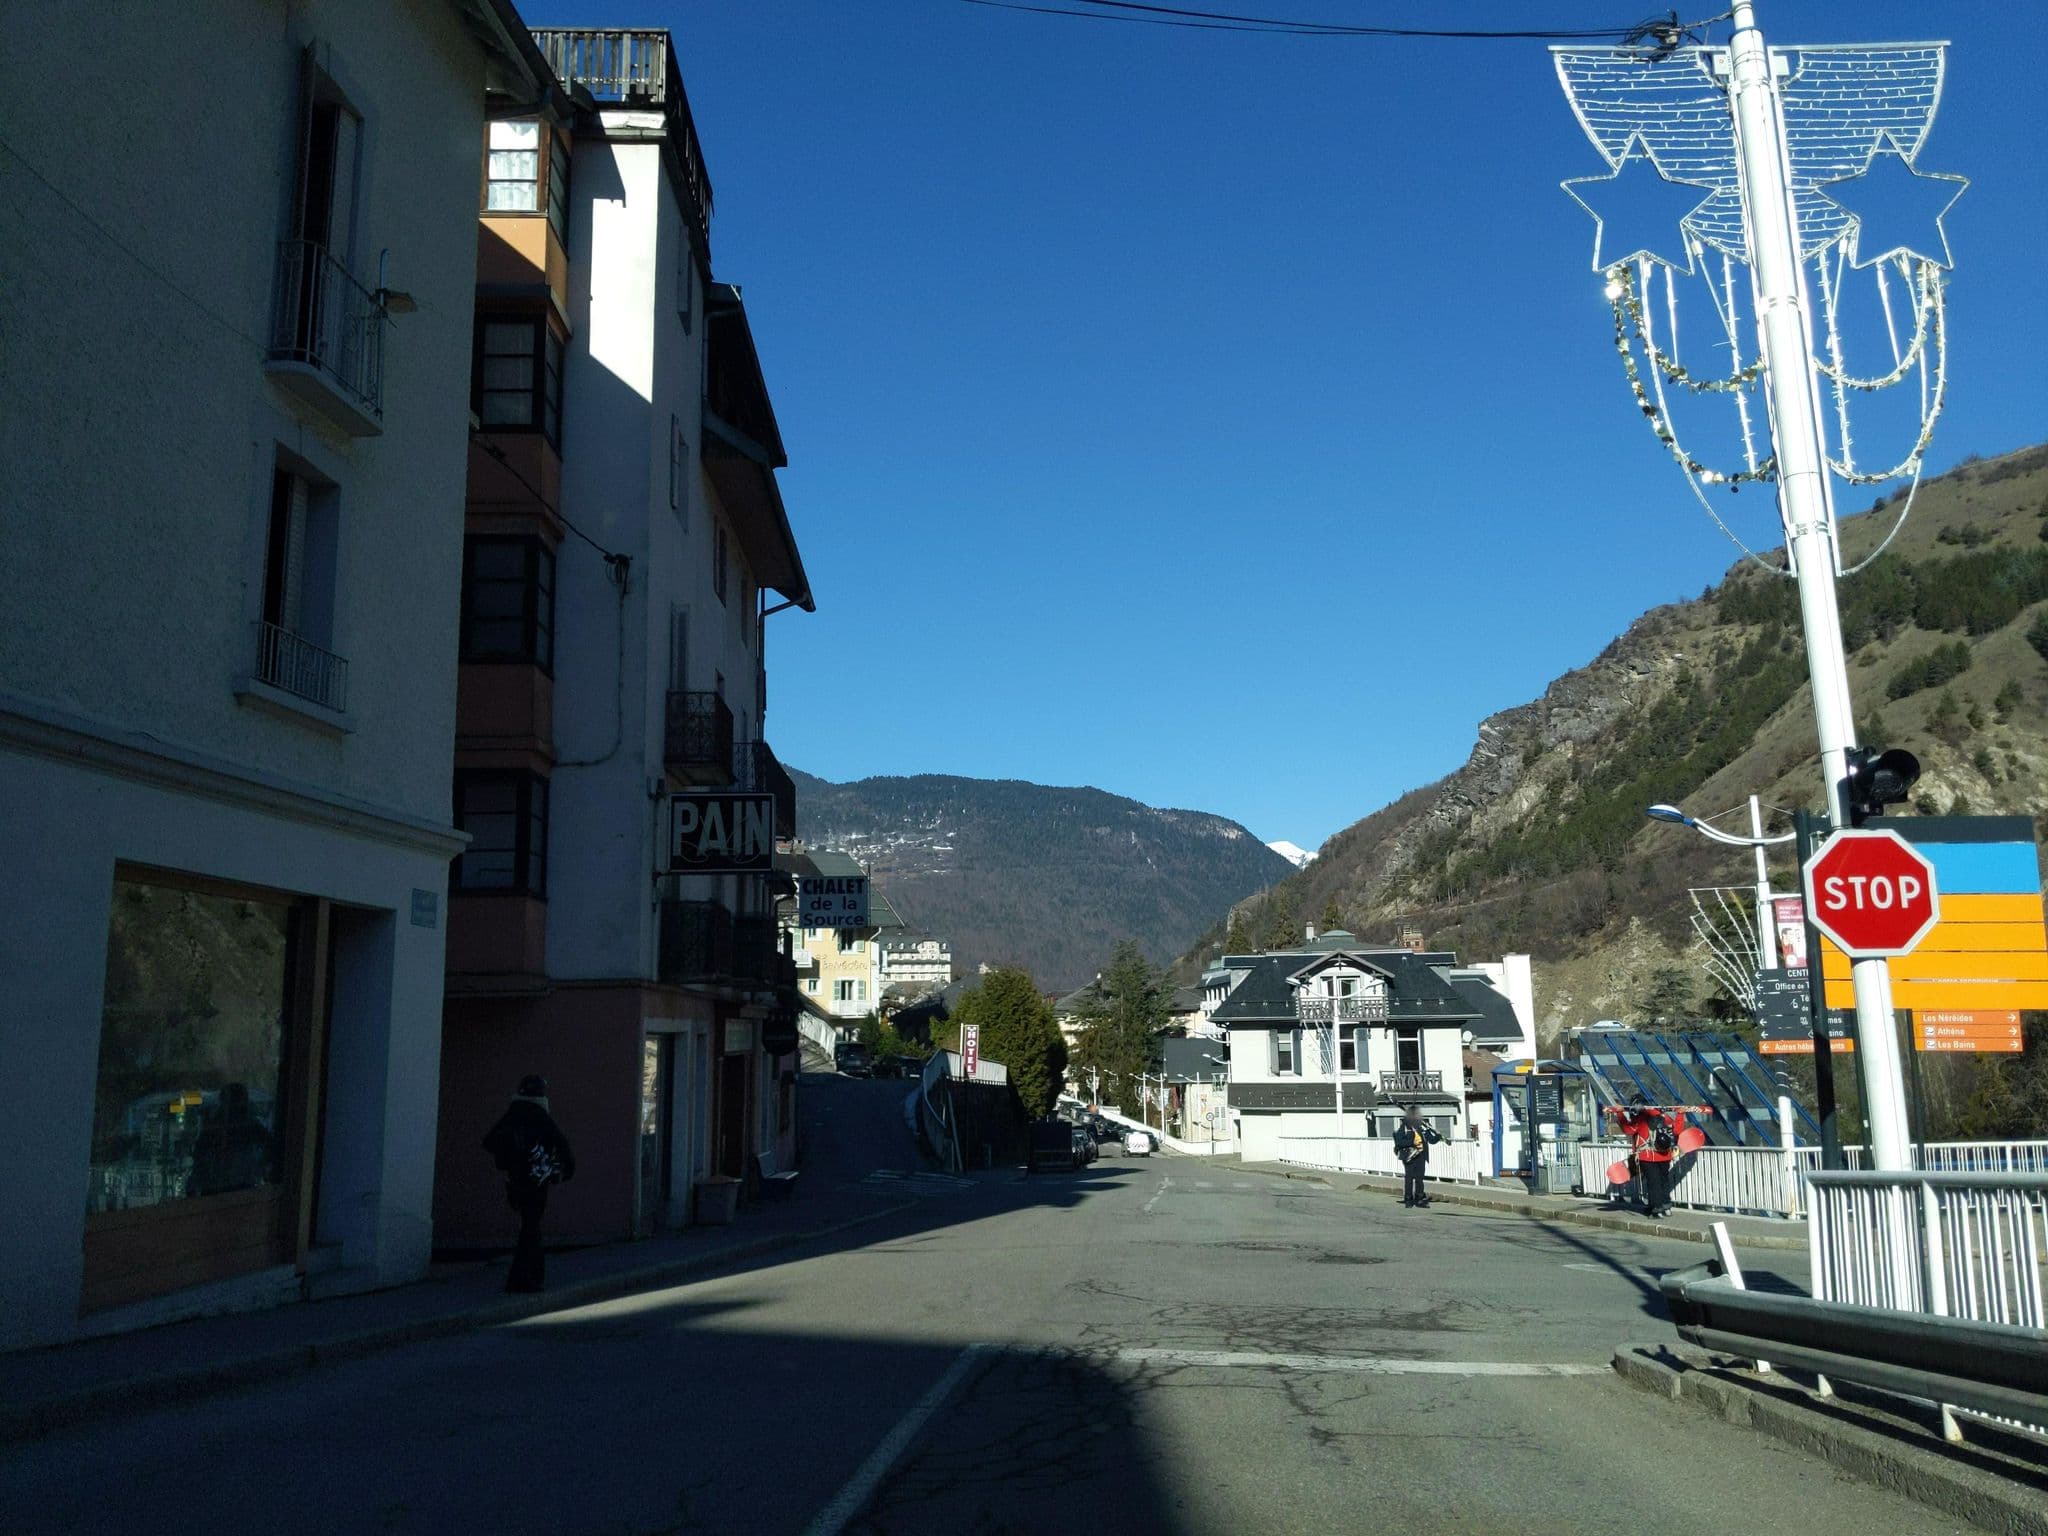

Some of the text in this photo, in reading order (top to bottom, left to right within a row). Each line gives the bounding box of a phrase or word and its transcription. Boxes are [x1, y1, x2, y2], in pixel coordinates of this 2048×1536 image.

[673, 801, 770, 856] PAIN
[802, 879, 864, 895] CHALET
[1824, 876, 1921, 910] STOP
[811, 897, 857, 910] de la
[803, 914, 865, 927] Source
[1787, 968, 1809, 978] CENT
[1775, 982, 1796, 991] Office
[1775, 1043, 1796, 1051] Autres
[1938, 1040, 1975, 1049] Les Bains
[966, 1031, 977, 1072] HOTEL
